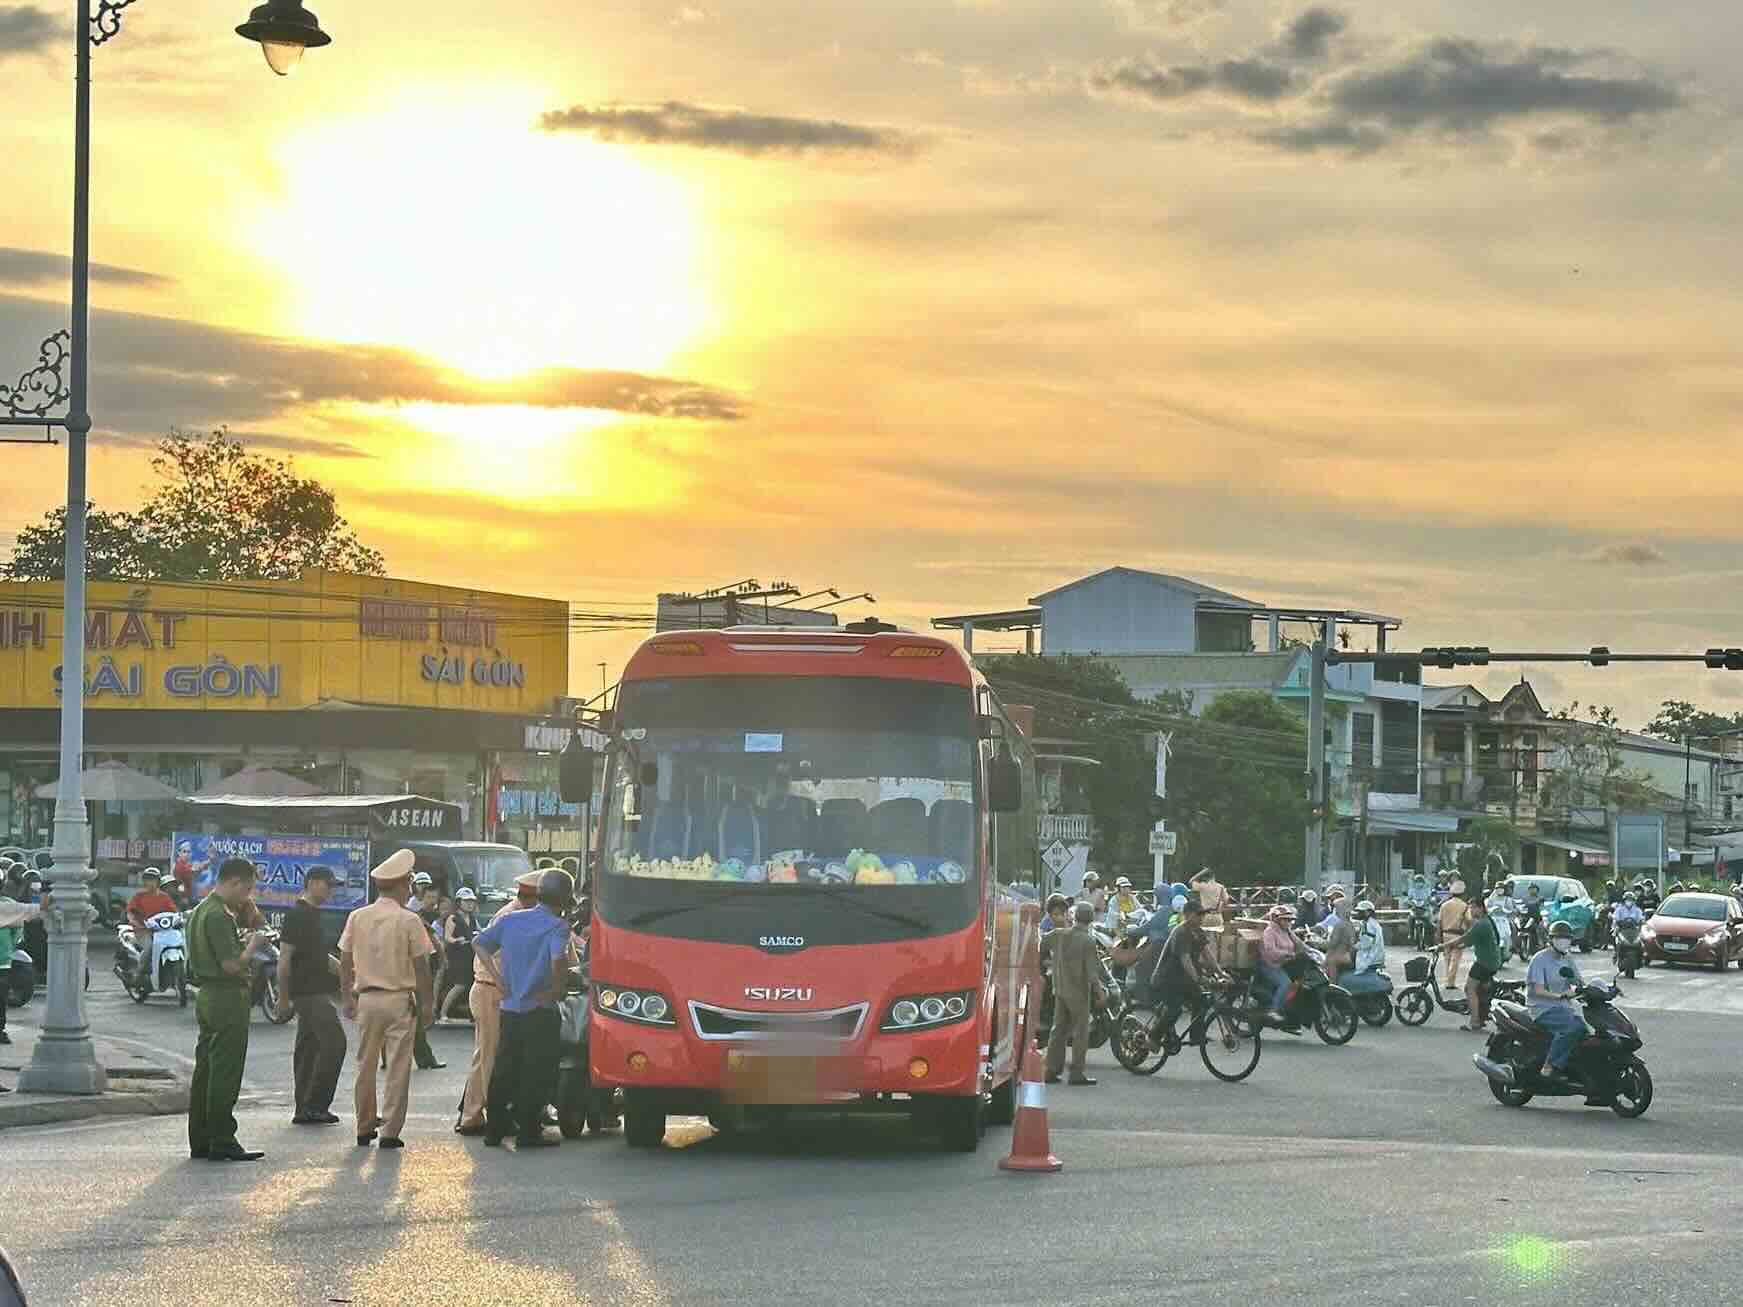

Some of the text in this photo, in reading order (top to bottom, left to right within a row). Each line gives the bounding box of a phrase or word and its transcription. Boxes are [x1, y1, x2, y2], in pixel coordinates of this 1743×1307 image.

[0, 610, 46, 649] H
[164, 652, 281, 698] GÒN
[387, 807, 444, 828] ASEAN
[759, 935, 805, 946] SAMCO
[743, 986, 813, 1001] ISUZU
